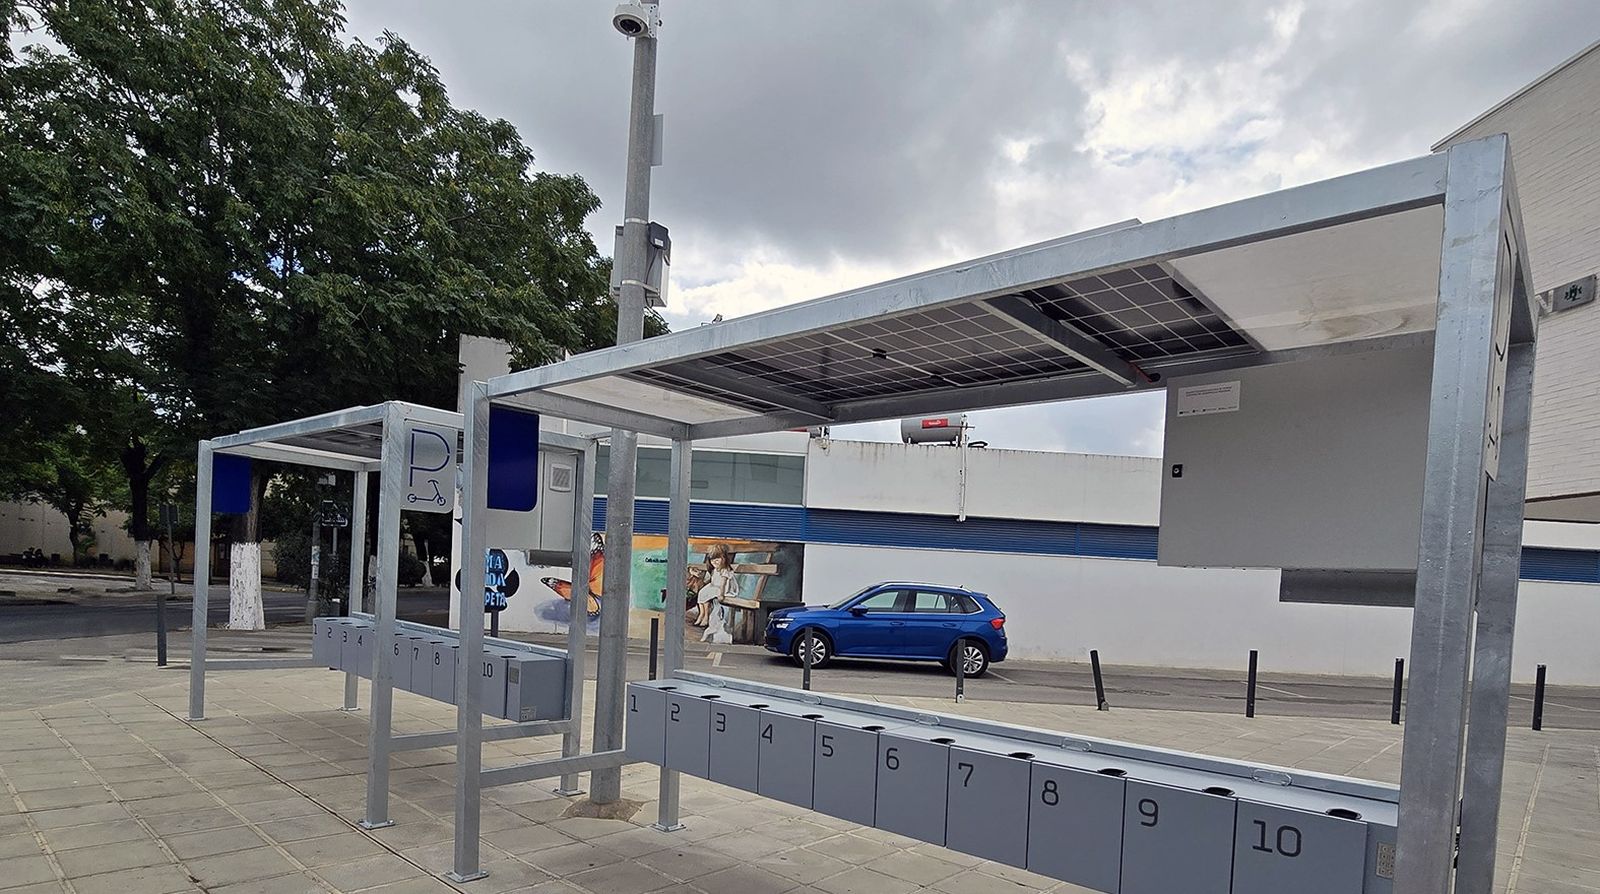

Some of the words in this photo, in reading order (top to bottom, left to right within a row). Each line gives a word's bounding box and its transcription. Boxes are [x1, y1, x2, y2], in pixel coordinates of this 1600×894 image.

[409, 428, 450, 487] P
[484, 592, 507, 606] PETA
[327, 626, 333, 639] 2
[343, 630, 348, 643] 3
[357, 634, 363, 646] 4
[393, 643, 400, 656] 6
[413, 647, 419, 660] 7
[434, 651, 440, 665] 8
[482, 661, 493, 678] 10
[631, 694, 639, 713] 1
[670, 703, 681, 722] 2
[716, 712, 726, 732] 3
[761, 724, 774, 744] 4
[822, 735, 834, 757] 5
[886, 747, 900, 770] 6
[957, 763, 975, 787] 7
[1041, 780, 1060, 806] 8
[1137, 799, 1159, 827] 9
[1252, 820, 1302, 858] 10
